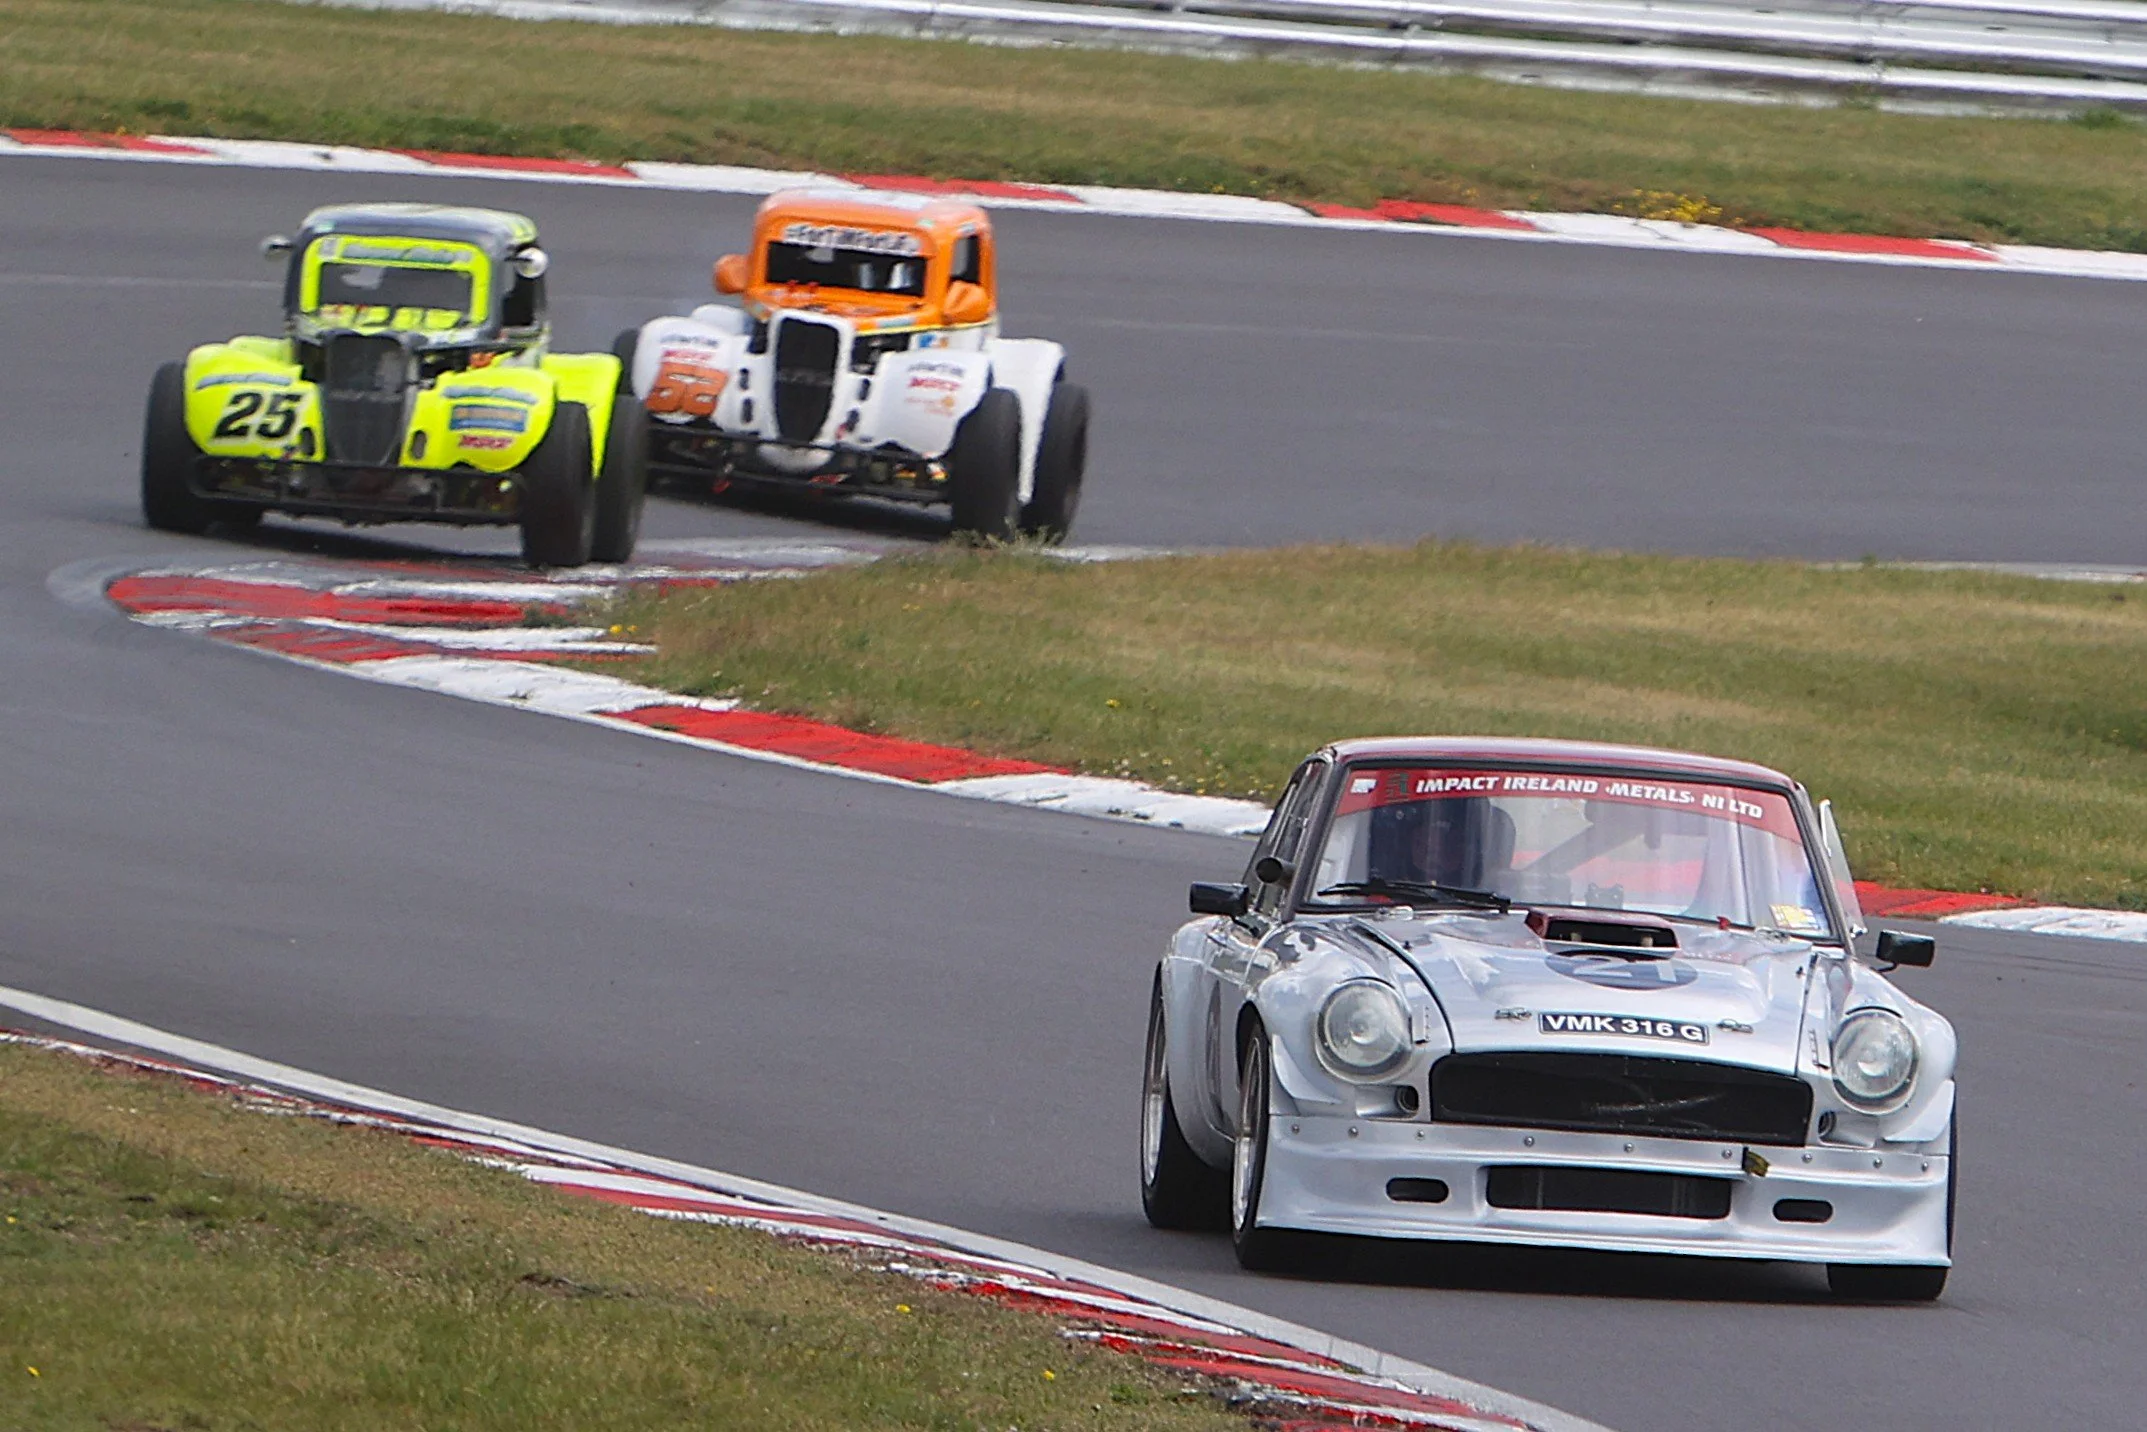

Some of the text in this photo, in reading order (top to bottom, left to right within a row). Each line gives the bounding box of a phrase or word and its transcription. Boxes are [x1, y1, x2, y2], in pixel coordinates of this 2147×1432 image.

[215, 392, 302, 438] 25
[1416, 776, 1499, 793] IMPACT
[1503, 777, 1599, 793] IRELAND
[1702, 793, 1725, 810] NI
[1729, 798, 1763, 819] LTD
[1546, 1015, 1703, 1041] VMK 316 G
